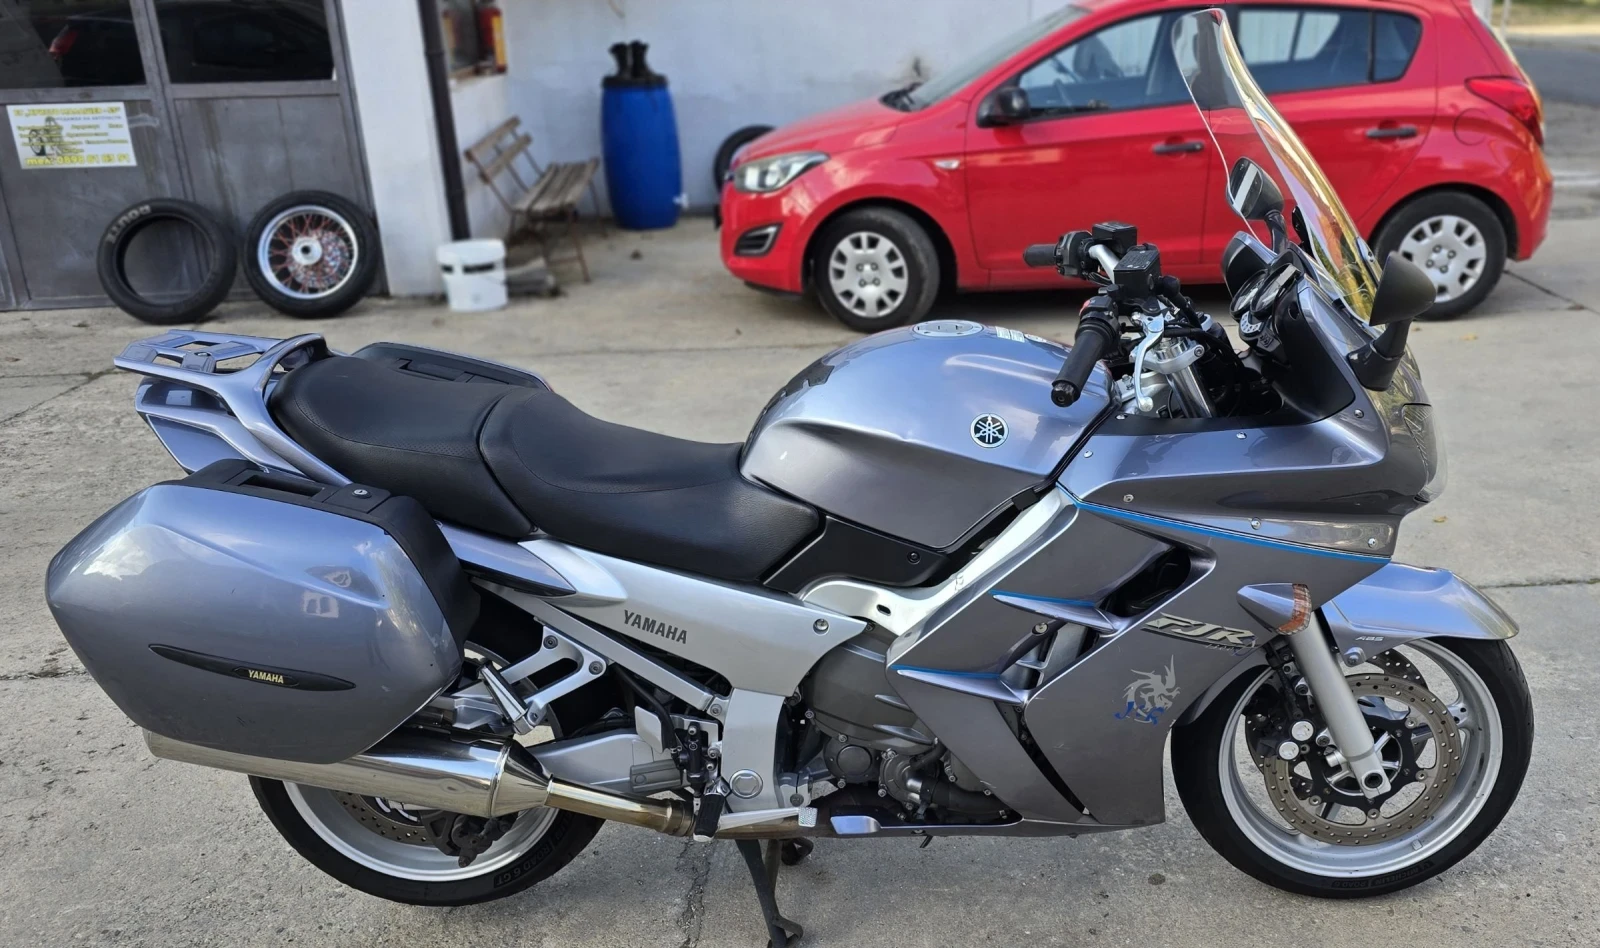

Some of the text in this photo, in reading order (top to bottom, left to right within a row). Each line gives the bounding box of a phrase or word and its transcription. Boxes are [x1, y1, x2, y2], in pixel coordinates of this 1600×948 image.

[624, 609, 688, 645] YAMAHA
[1144, 611, 1256, 645] FJR
[248, 669, 284, 684] YAMAHA
